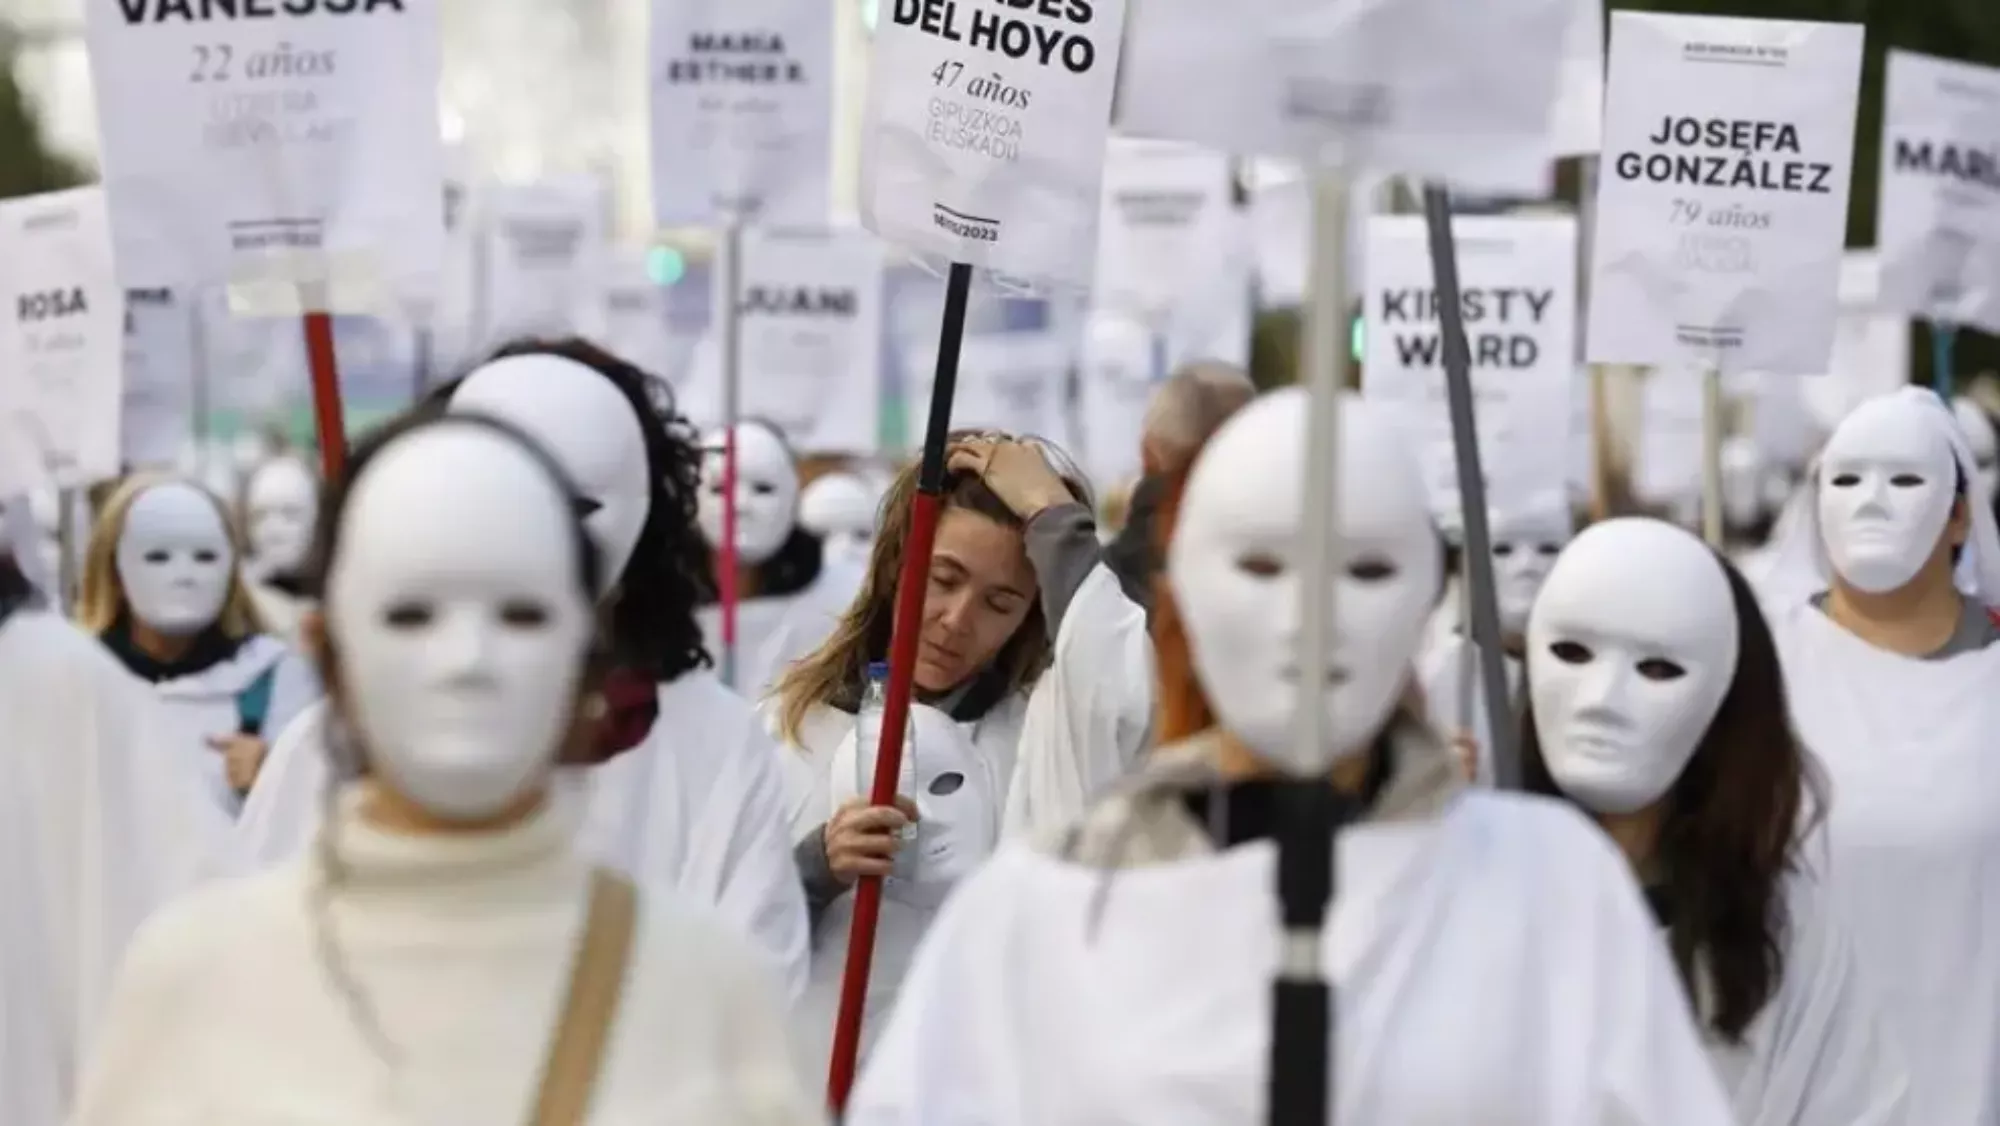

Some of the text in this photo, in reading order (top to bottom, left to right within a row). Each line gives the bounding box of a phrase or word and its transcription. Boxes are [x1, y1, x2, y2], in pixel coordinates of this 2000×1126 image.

[117, 0, 405, 25] VANE
[893, 0, 1095, 73] DEL HOYO
[189, 41, 337, 83] 22 años
[930, 60, 1032, 110] 47 años
[927, 96, 1022, 142] GIPUZKOA
[1650, 115, 1802, 154] JOSEFA
[1616, 150, 1833, 194] GONZÁLEZ
[1669, 198, 1771, 230] 79 años
[1395, 333, 1538, 369] WRD
